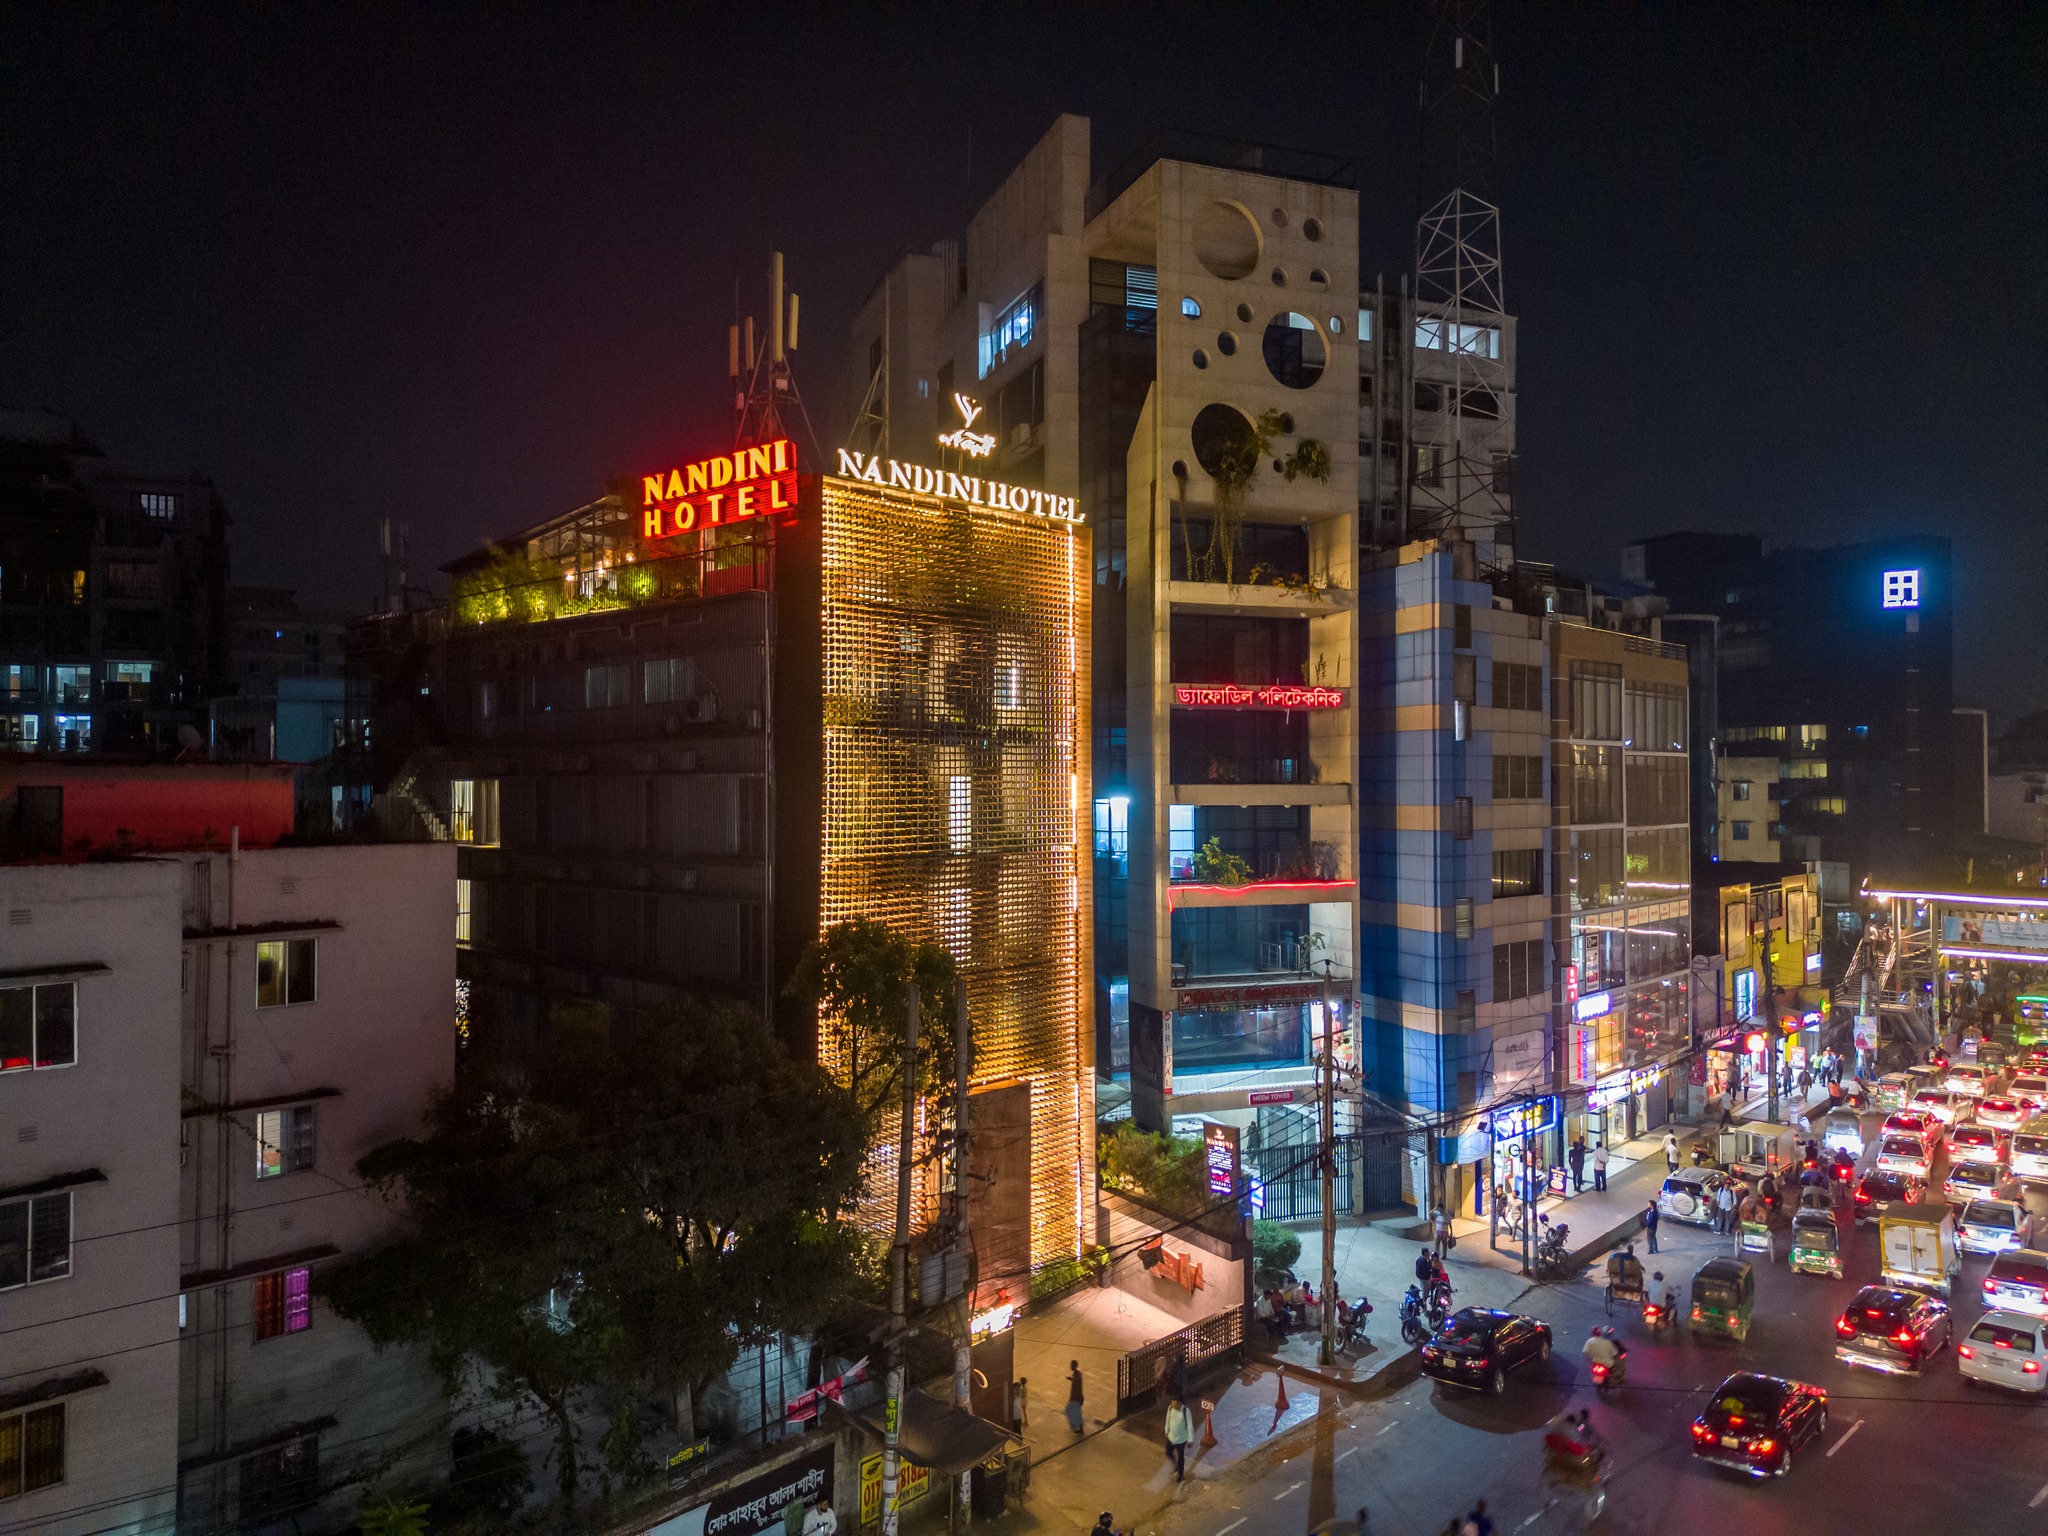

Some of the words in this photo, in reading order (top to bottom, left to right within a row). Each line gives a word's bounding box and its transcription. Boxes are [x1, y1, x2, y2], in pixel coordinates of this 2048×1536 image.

[643, 439, 788, 506] NANDINI
[836, 447, 983, 505] NANDINI
[987, 479, 1087, 524] HOTEL
[644, 479, 789, 538] HOTEL
[1176, 685, 1254, 705] ড্যাফোডিল
[1257, 685, 1343, 708] পলিটেকনিক
[1164, 1023, 1172, 1087] BRIDAL
[1270, 1092, 1291, 1100] TOWER
[769, 1482, 796, 1506] আলম
[796, 1468, 825, 1494] শাহীন
